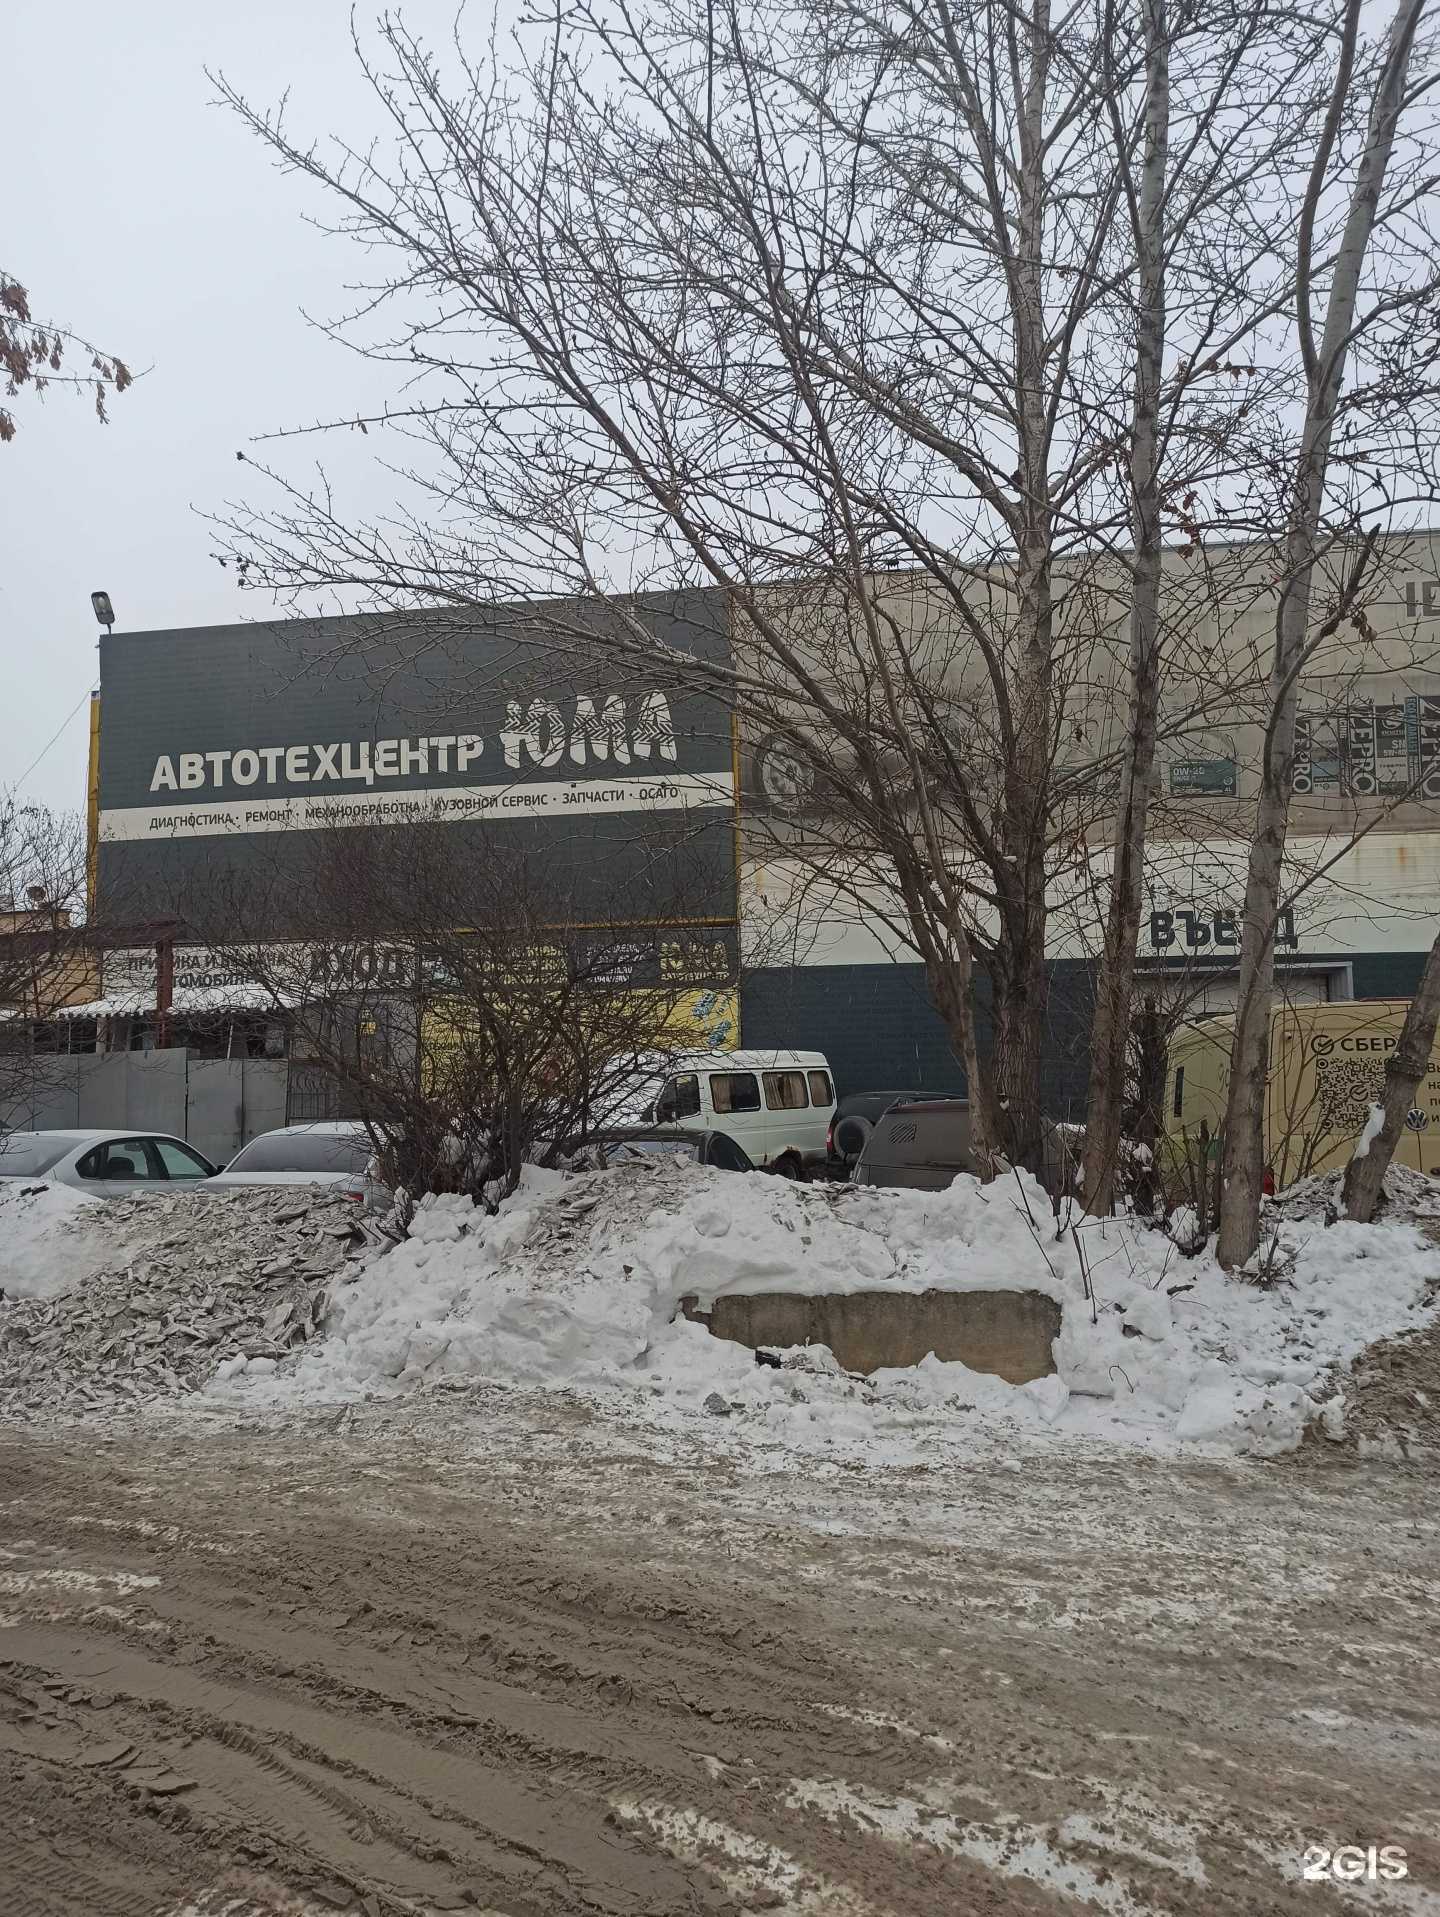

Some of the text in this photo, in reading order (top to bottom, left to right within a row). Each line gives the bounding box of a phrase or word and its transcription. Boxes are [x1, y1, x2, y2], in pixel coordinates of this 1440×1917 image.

[150, 689, 678, 792] АВТОТЕХЦЕНТР ЮМА
[149, 786, 679, 830] ДИАГНОСТИКА РЕМОНТ МЕХАНООБРАБОТКА КУЗОВНОЙ СЕРВИС ЗАПЧАСТИ ОСАГО
[1150, 907, 1298, 949] ВЪЕД
[1340, 1037, 1397, 1052] СБЕР
